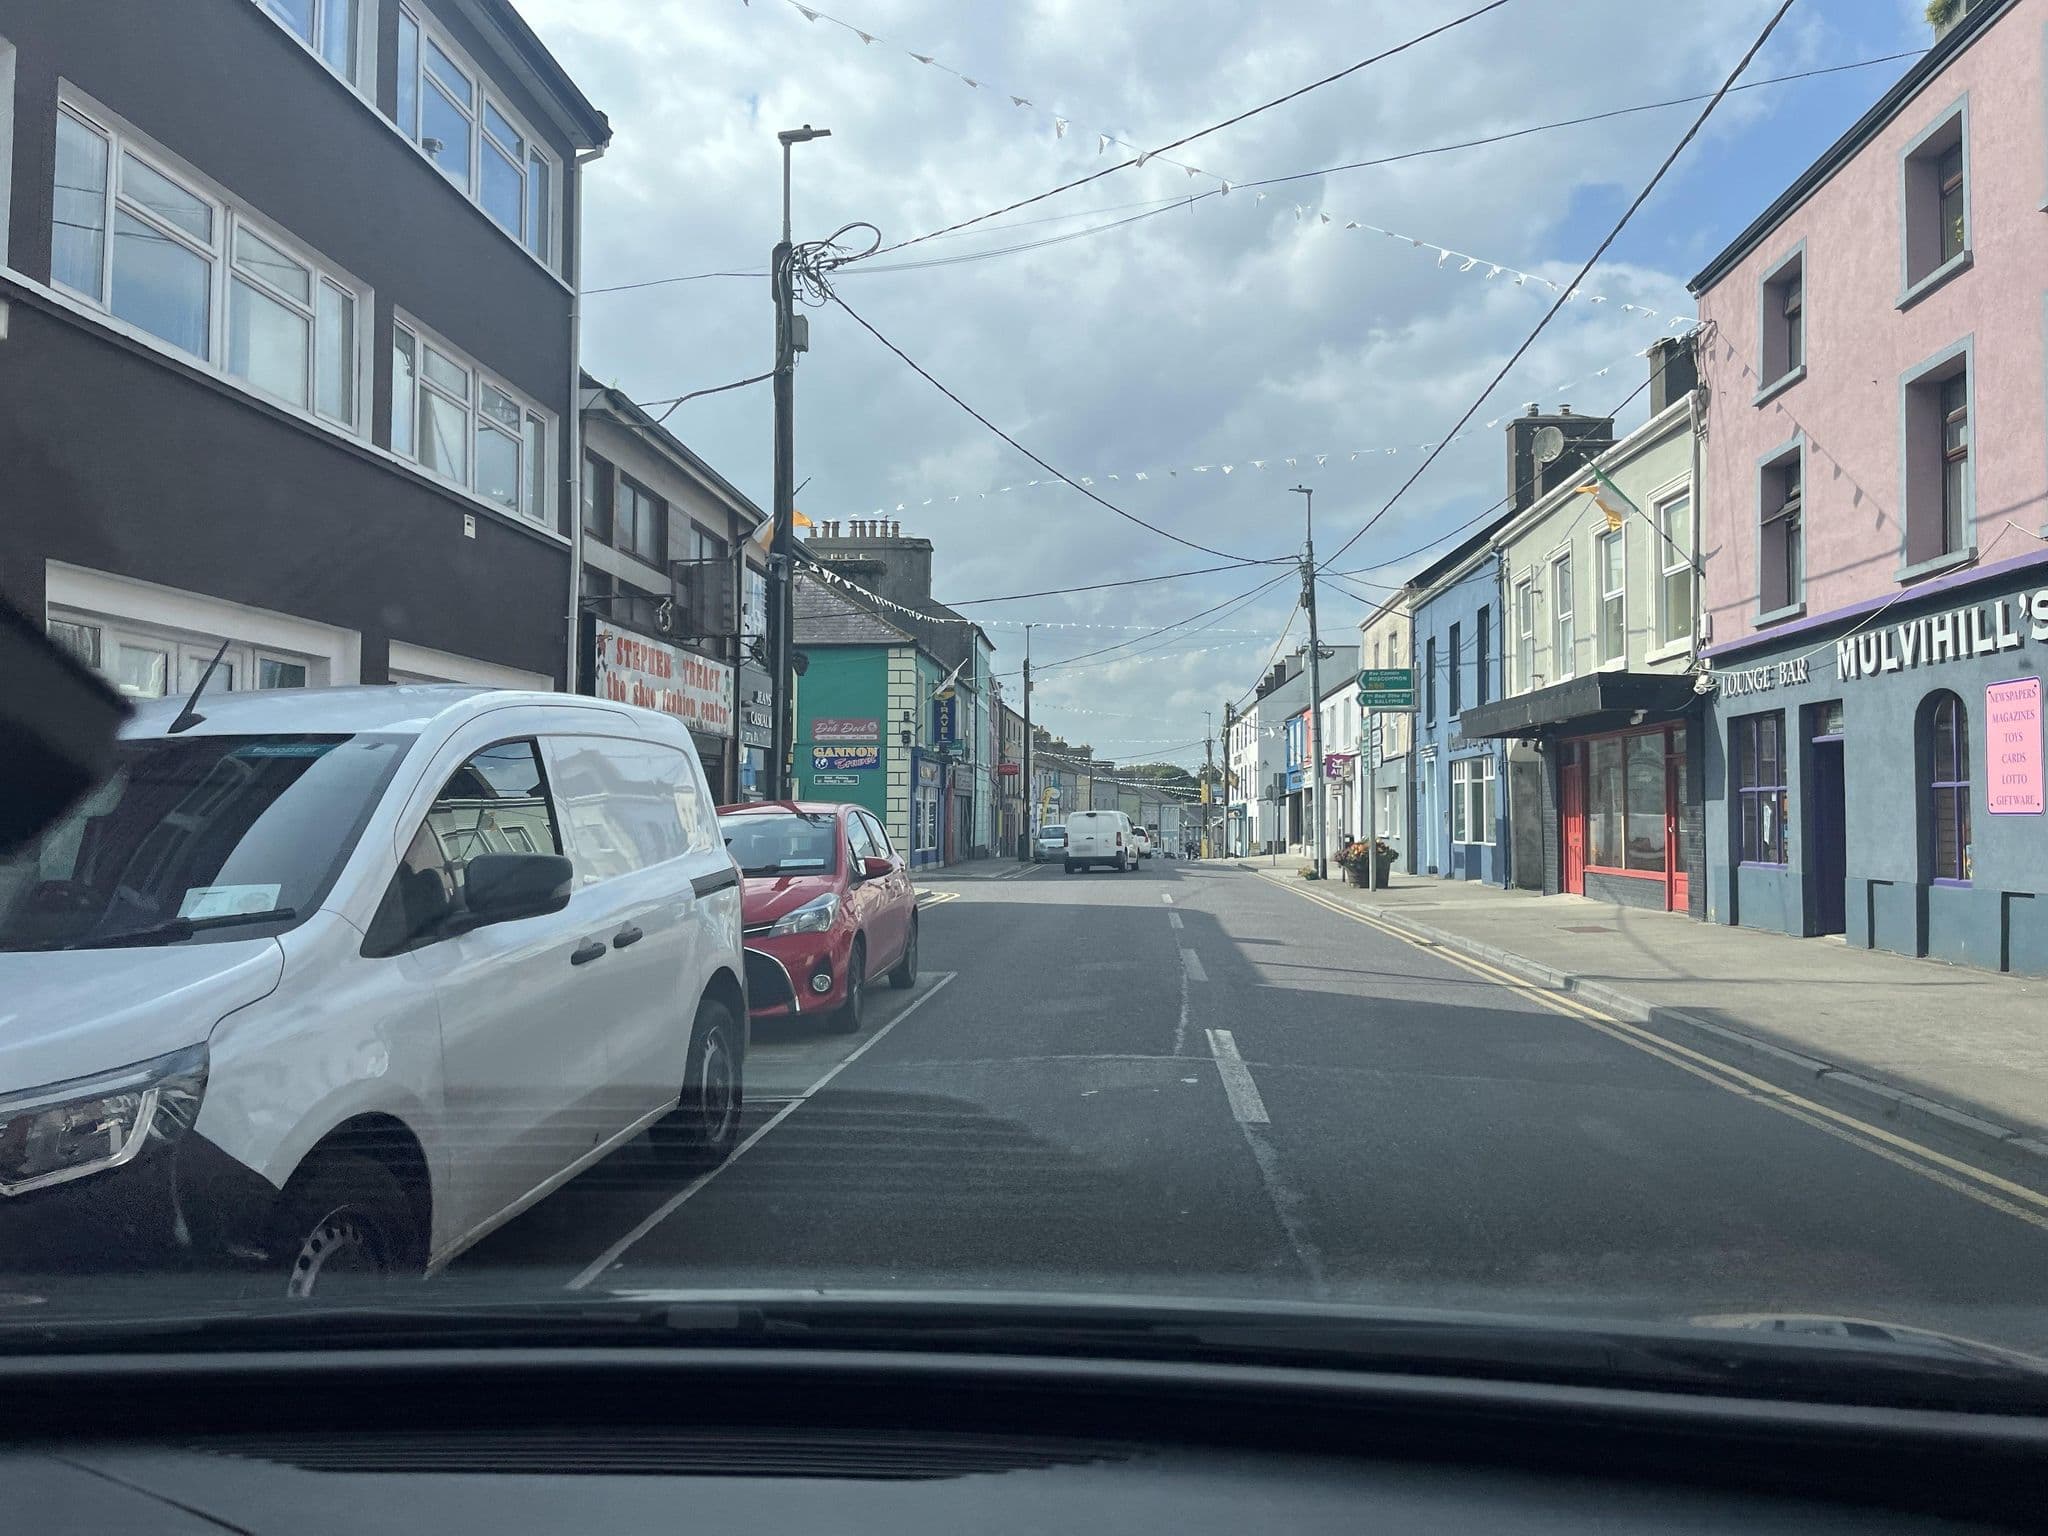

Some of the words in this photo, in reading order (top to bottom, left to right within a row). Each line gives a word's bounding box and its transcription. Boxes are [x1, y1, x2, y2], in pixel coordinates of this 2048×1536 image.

[1836, 589, 2048, 680] MULVIHILL'S
[616, 637, 672, 680] STEPHEN
[1721, 665, 1771, 698] LOUNGE
[1778, 655, 1809, 687] BAR
[607, 671, 626, 701] the
[633, 678, 656, 709] shoe
[662, 688, 696, 718] fashion
[700, 700, 727, 725] centre
[1990, 687, 2037, 703] NEWSPAPERS
[940, 700, 949, 740] TRAVEL
[1992, 709, 2035, 724] MAGAZINES
[2003, 731, 2024, 743] TOYS
[813, 746, 878, 758] GANNON
[2001, 752, 2027, 764] CARDS
[834, 755, 877, 769] Travel
[2001, 773, 2028, 785] LOTTO
[1996, 794, 2036, 806] GIFTWARE
